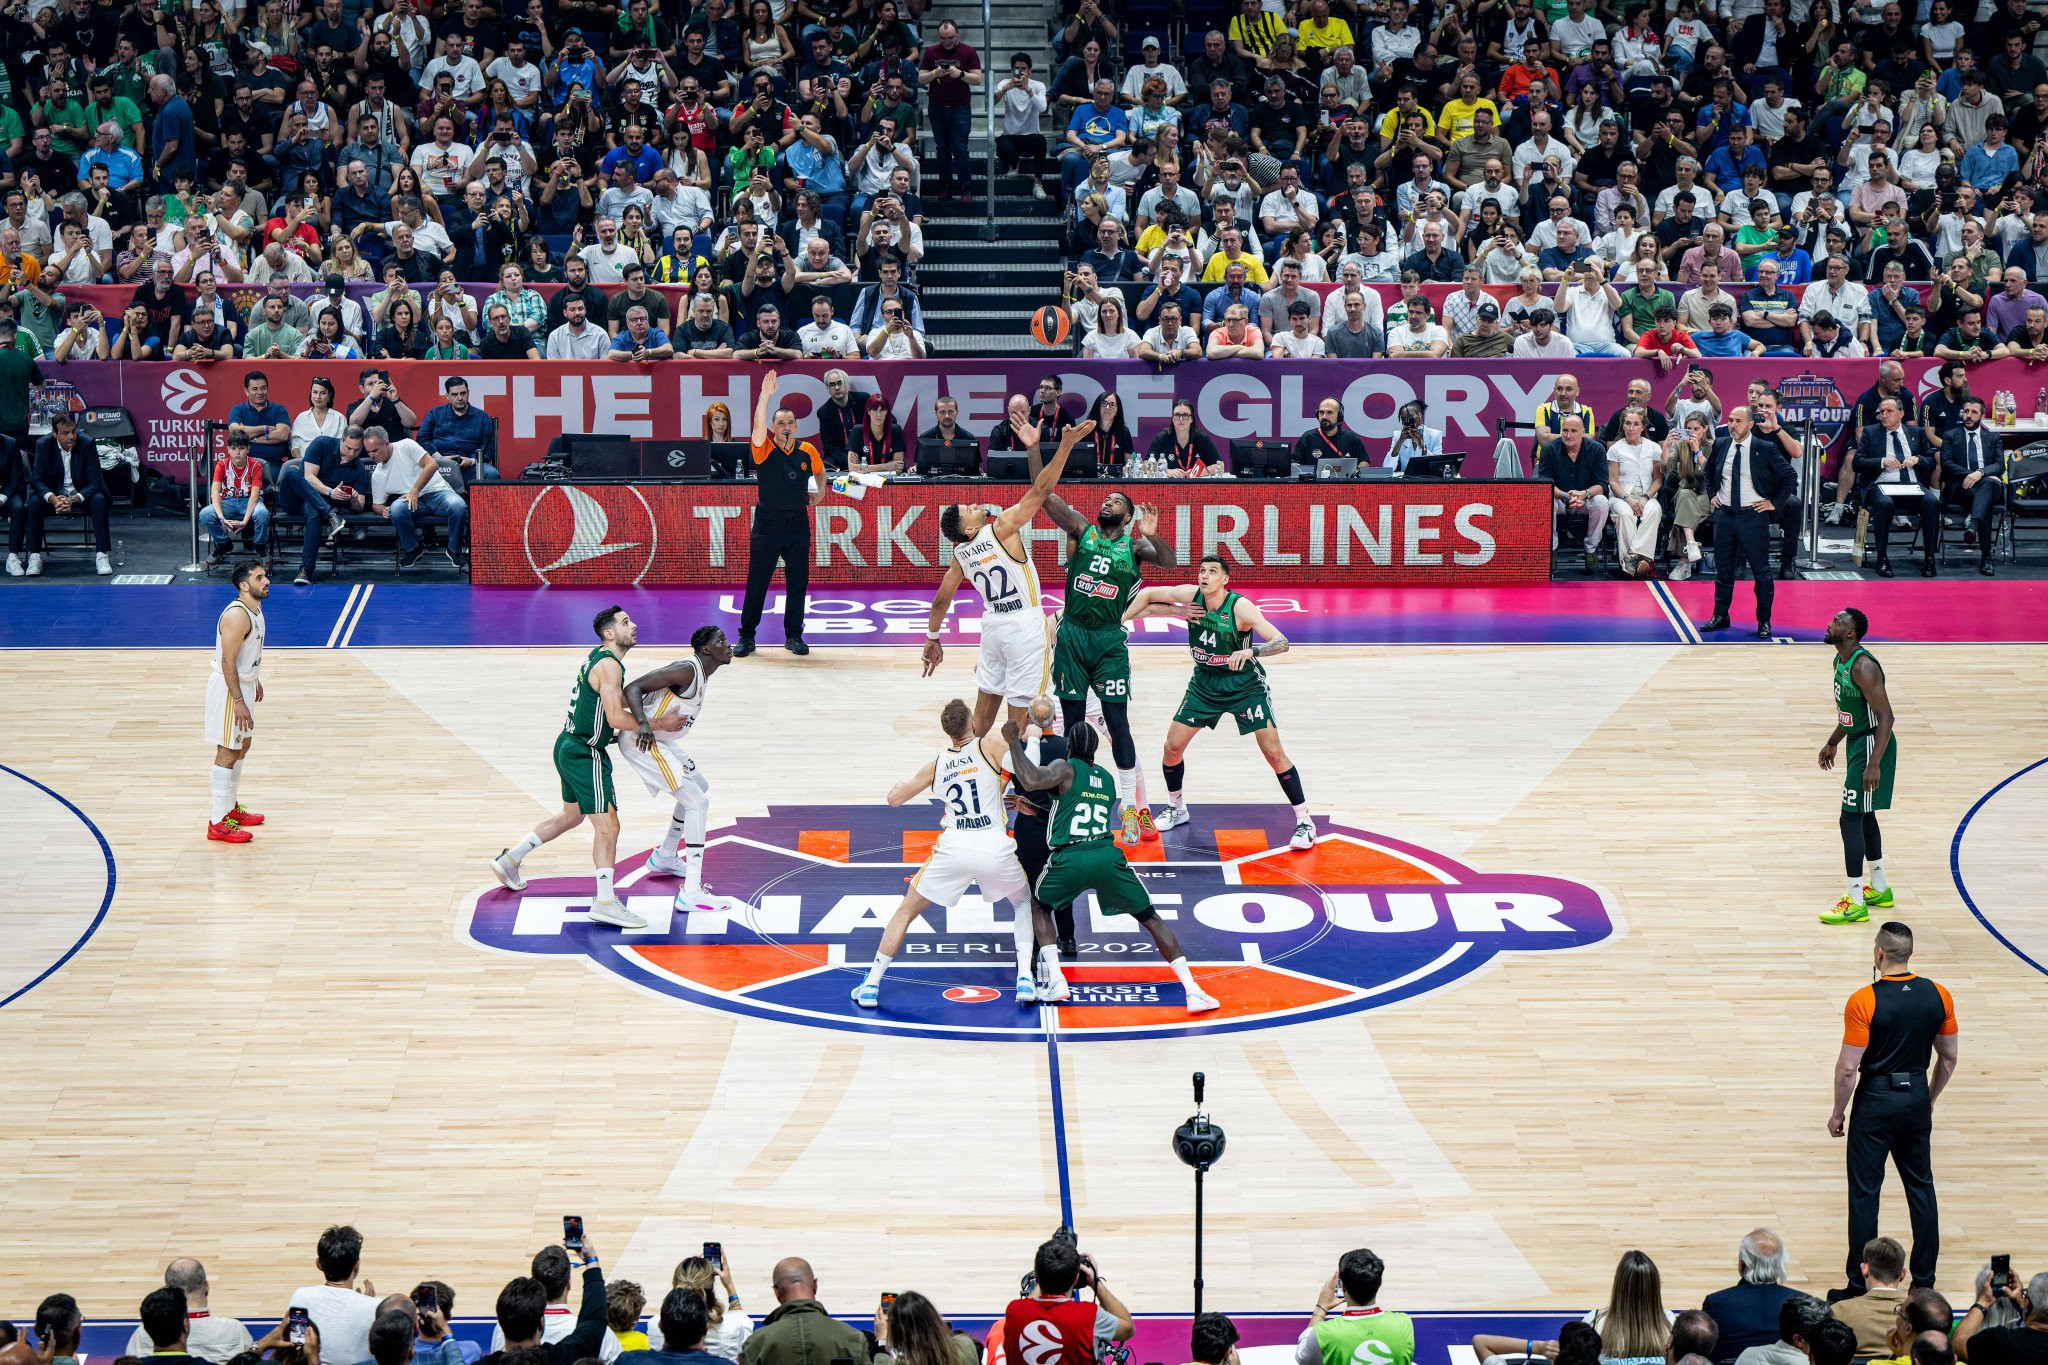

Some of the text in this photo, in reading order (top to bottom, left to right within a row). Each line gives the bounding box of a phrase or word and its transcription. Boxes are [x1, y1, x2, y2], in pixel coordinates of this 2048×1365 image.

[439, 375, 653, 438] THE
[1197, 373, 1560, 439] GLORY
[1810, 408, 1852, 422] FOUR
[148, 434, 225, 448] AIRLINS
[1126, 502, 1497, 567] IRLINES
[1088, 554, 1112, 575] 26
[973, 565, 1018, 602] 22
[993, 599, 1023, 613] MADRID
[1198, 629, 1217, 648] 44
[1105, 678, 1127, 697] 26
[944, 756, 974, 772] MUSA
[945, 778, 981, 817] 31
[956, 815, 992, 830] MADRID
[1069, 802, 1109, 837] 25
[511, 891, 1578, 936] FINAL FOUR
[1078, 942, 1160, 953] 202
